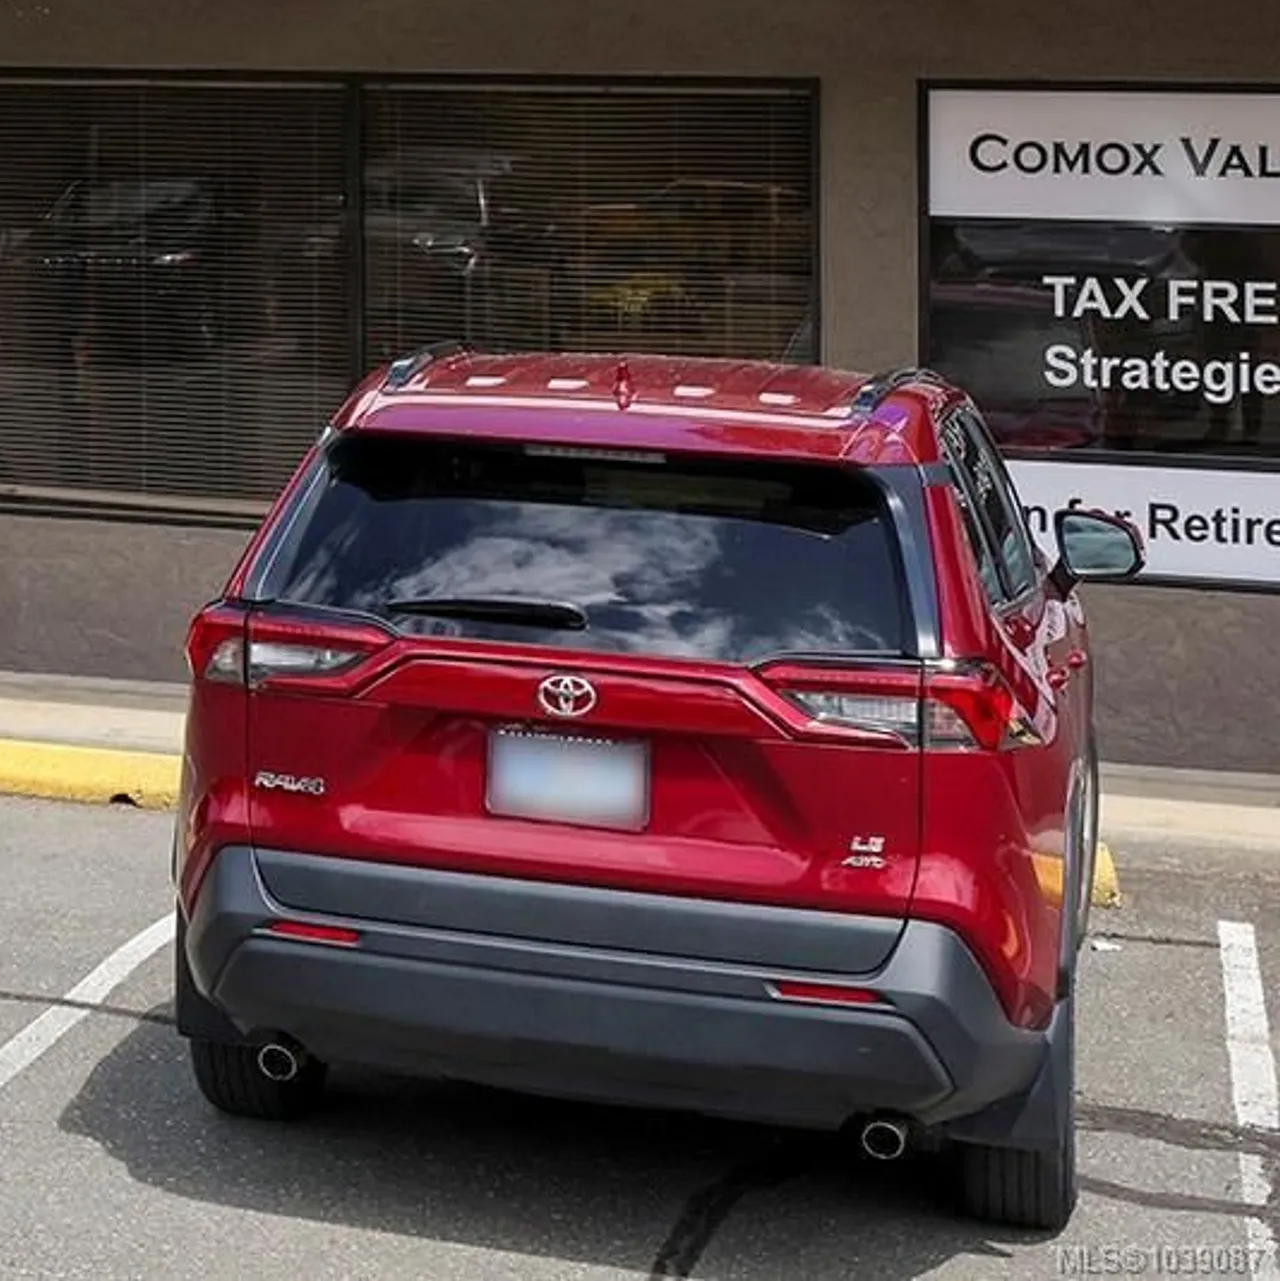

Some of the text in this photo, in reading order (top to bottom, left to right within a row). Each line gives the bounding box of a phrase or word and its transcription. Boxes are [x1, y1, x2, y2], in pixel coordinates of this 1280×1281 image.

[1042, 275, 1280, 324] TAX FRE
[1043, 344, 1280, 404] Strategie
[1148, 502, 1280, 547] Retire
